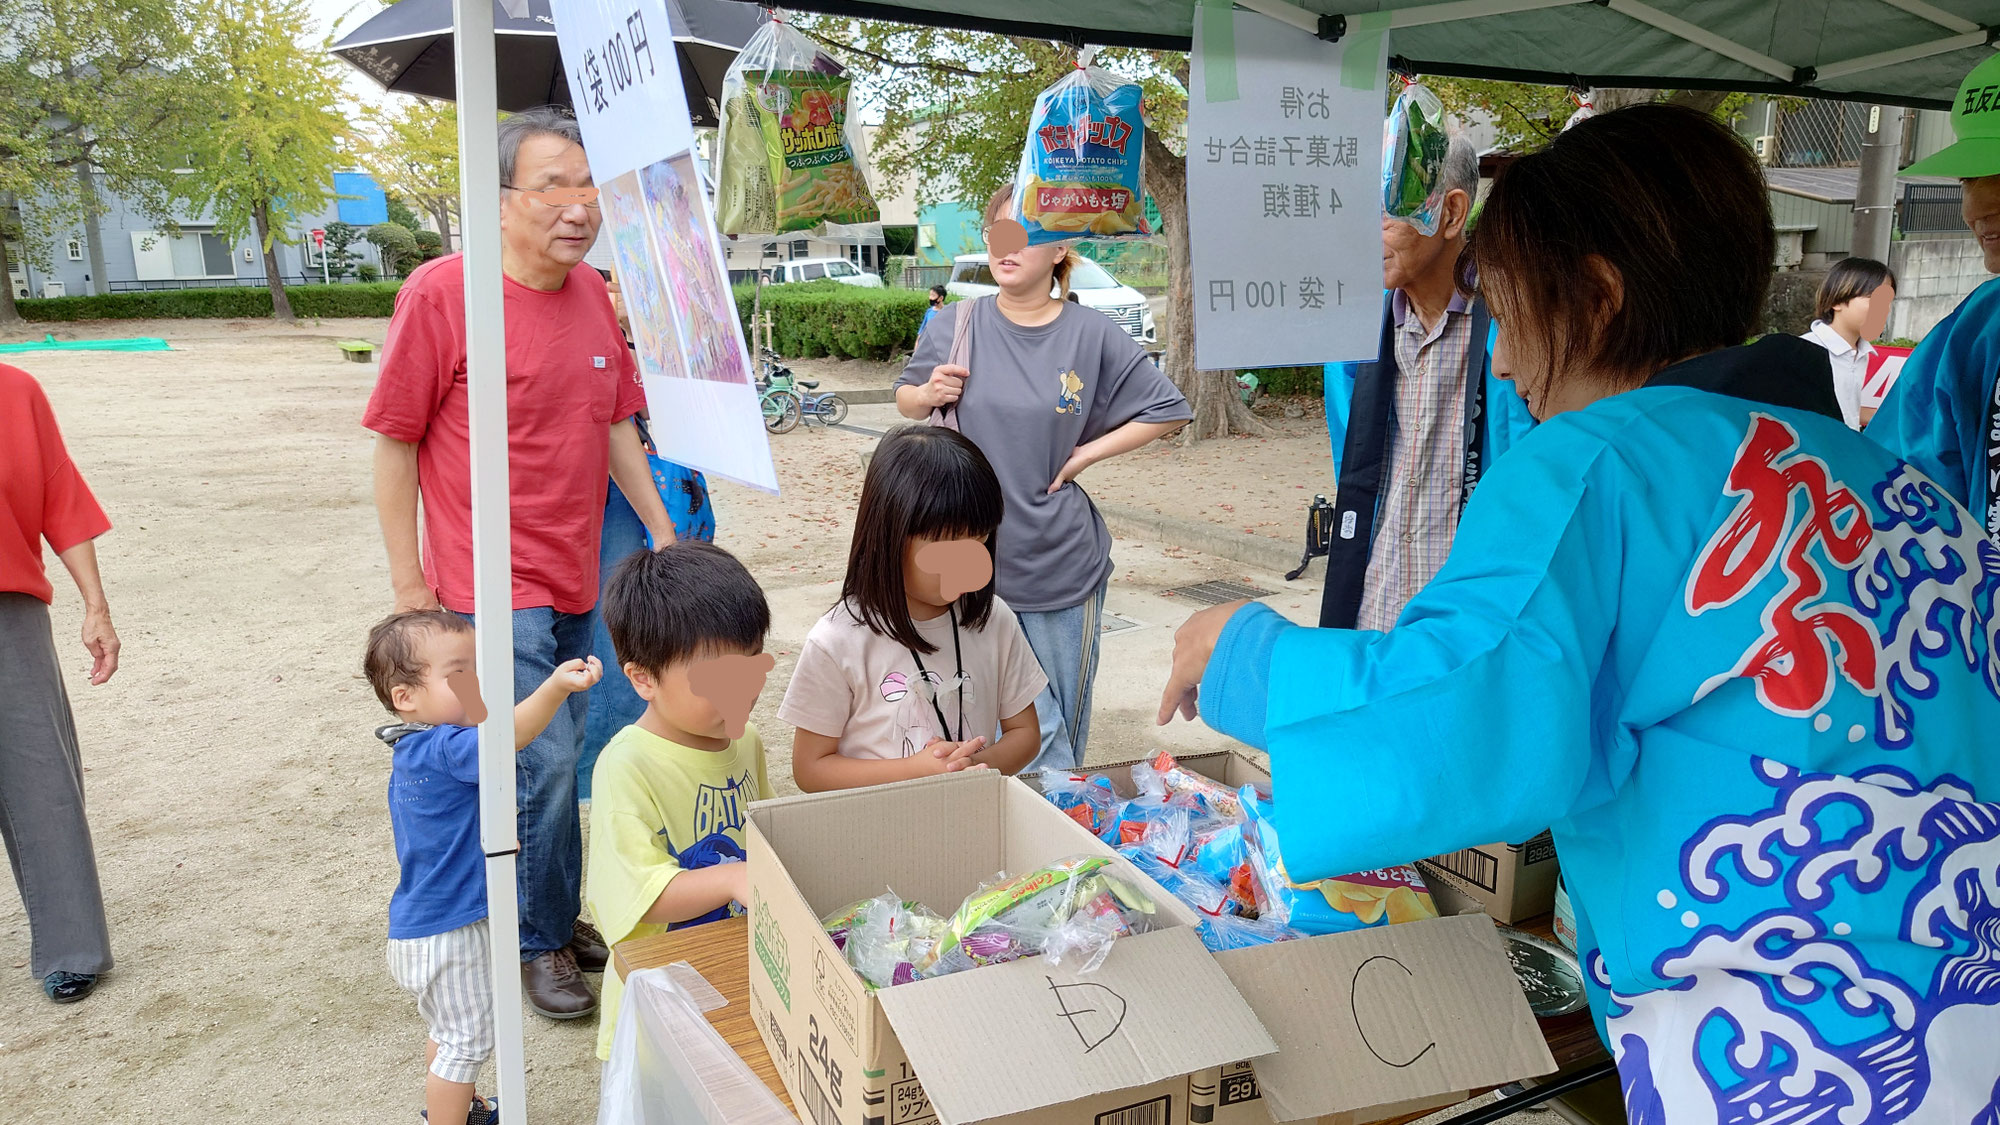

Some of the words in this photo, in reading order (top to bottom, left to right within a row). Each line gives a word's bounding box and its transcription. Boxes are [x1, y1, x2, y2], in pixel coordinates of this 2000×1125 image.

[576, 8, 655, 115] 1袋100円
[1038, 115, 1133, 154] ポテトチップス
[1043, 156, 1075, 165] KOIKEYA
[1107, 158, 1128, 167] CHIPS
[1040, 192, 1127, 210] じゃがいもと塩
[694, 769, 758, 843] BATM
[1010, 872, 1053, 899] Calbee
[1351, 954, 1436, 1068] C
[809, 1013, 843, 1109] 24g
